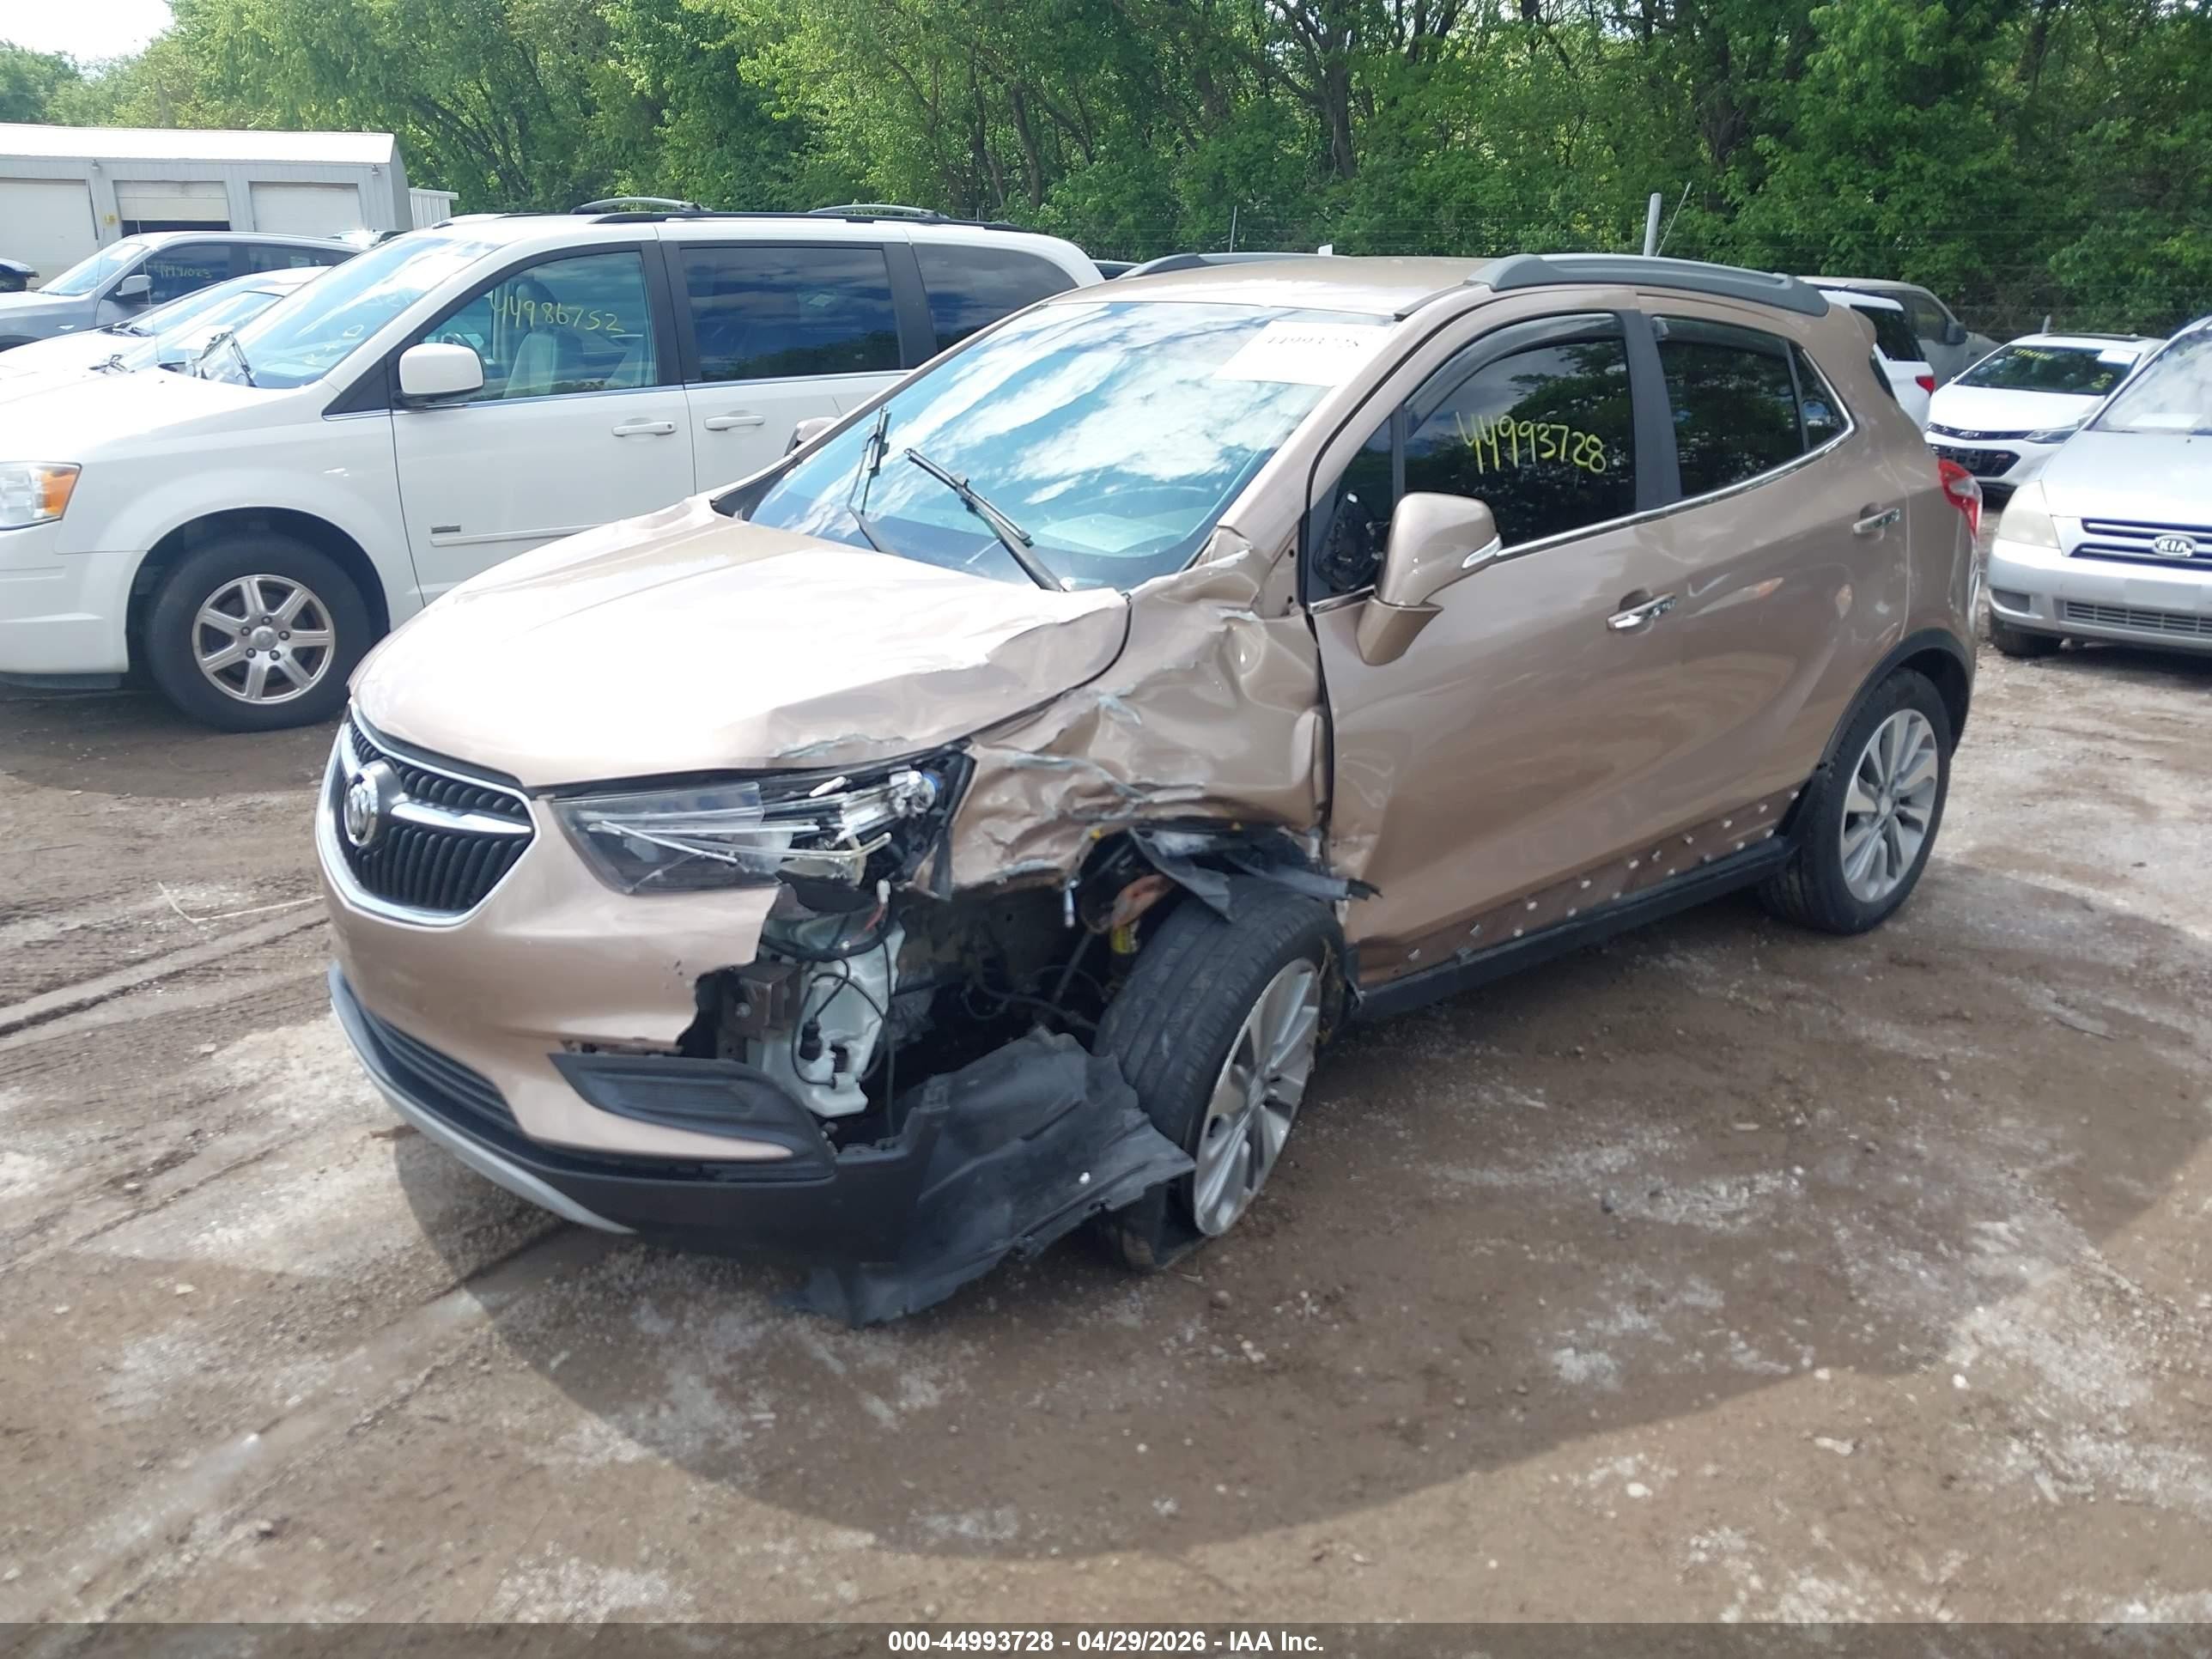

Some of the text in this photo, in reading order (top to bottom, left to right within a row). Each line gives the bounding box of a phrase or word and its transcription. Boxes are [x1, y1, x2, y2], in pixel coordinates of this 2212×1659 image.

[489, 295, 625, 333] 44986752
[1455, 411, 1607, 474] 44993728
[2158, 539, 2187, 552] KIA
